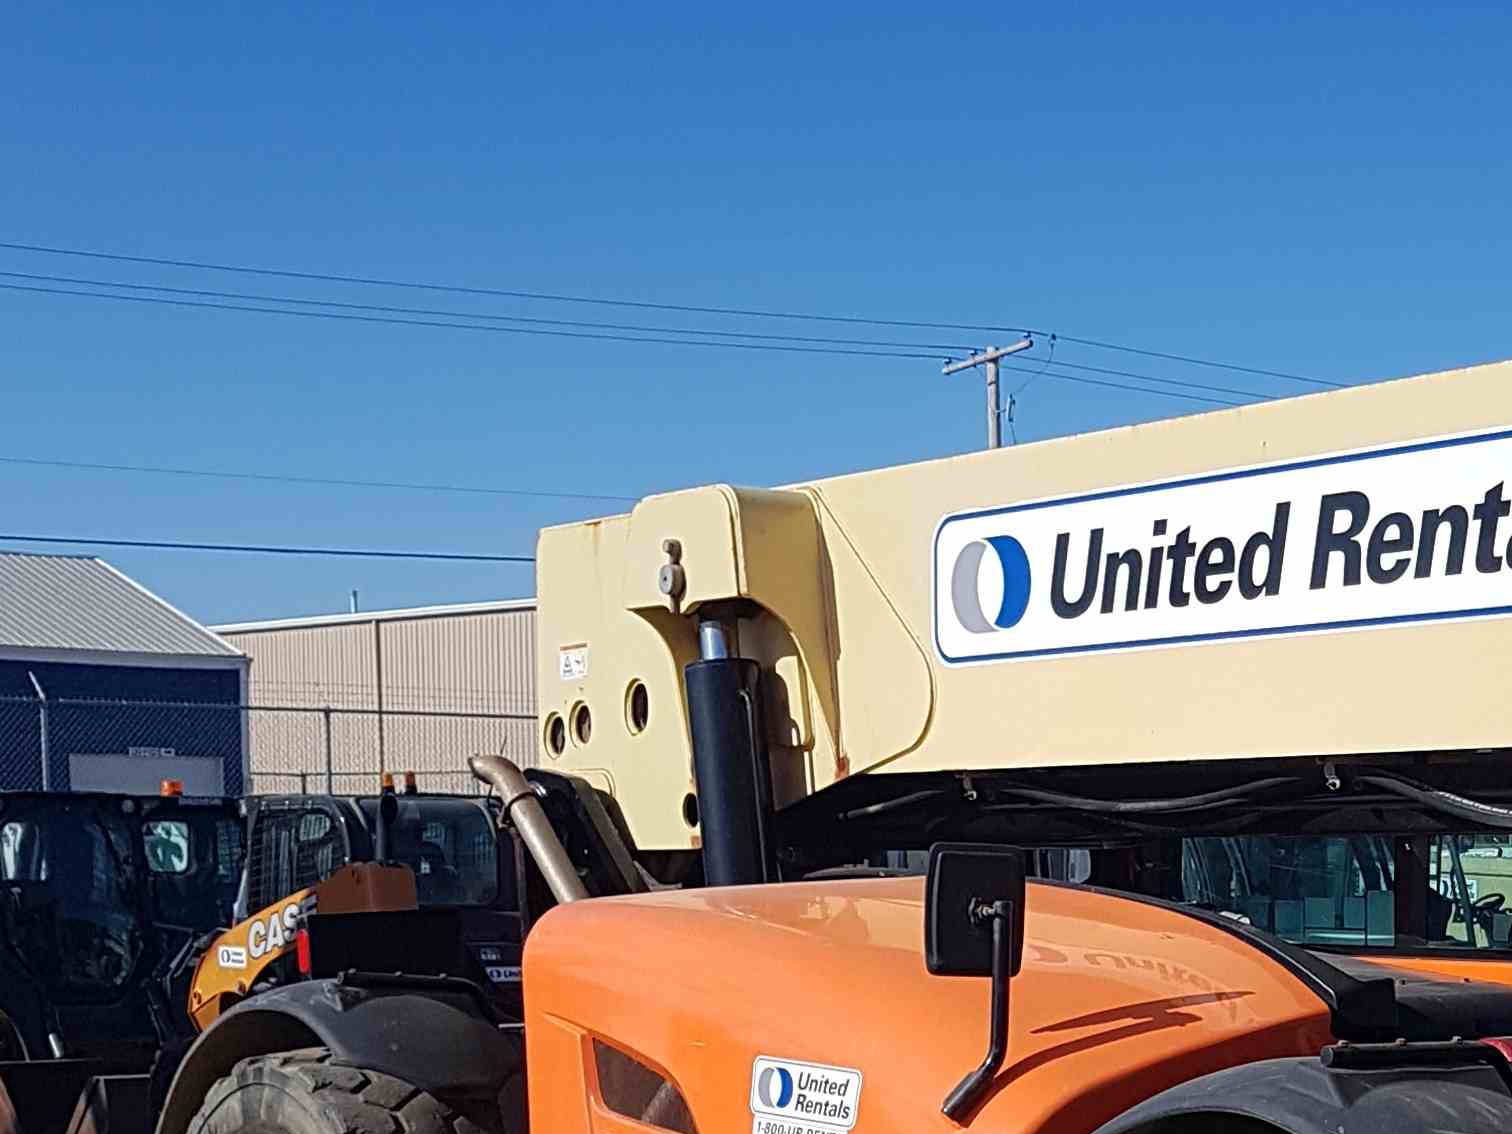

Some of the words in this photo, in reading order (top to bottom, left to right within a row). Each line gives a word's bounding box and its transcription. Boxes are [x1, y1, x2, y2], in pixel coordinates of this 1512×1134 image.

[1049, 502, 1291, 618] United
[797, 1071, 850, 1097] United
[795, 1093, 851, 1119] Rentals
